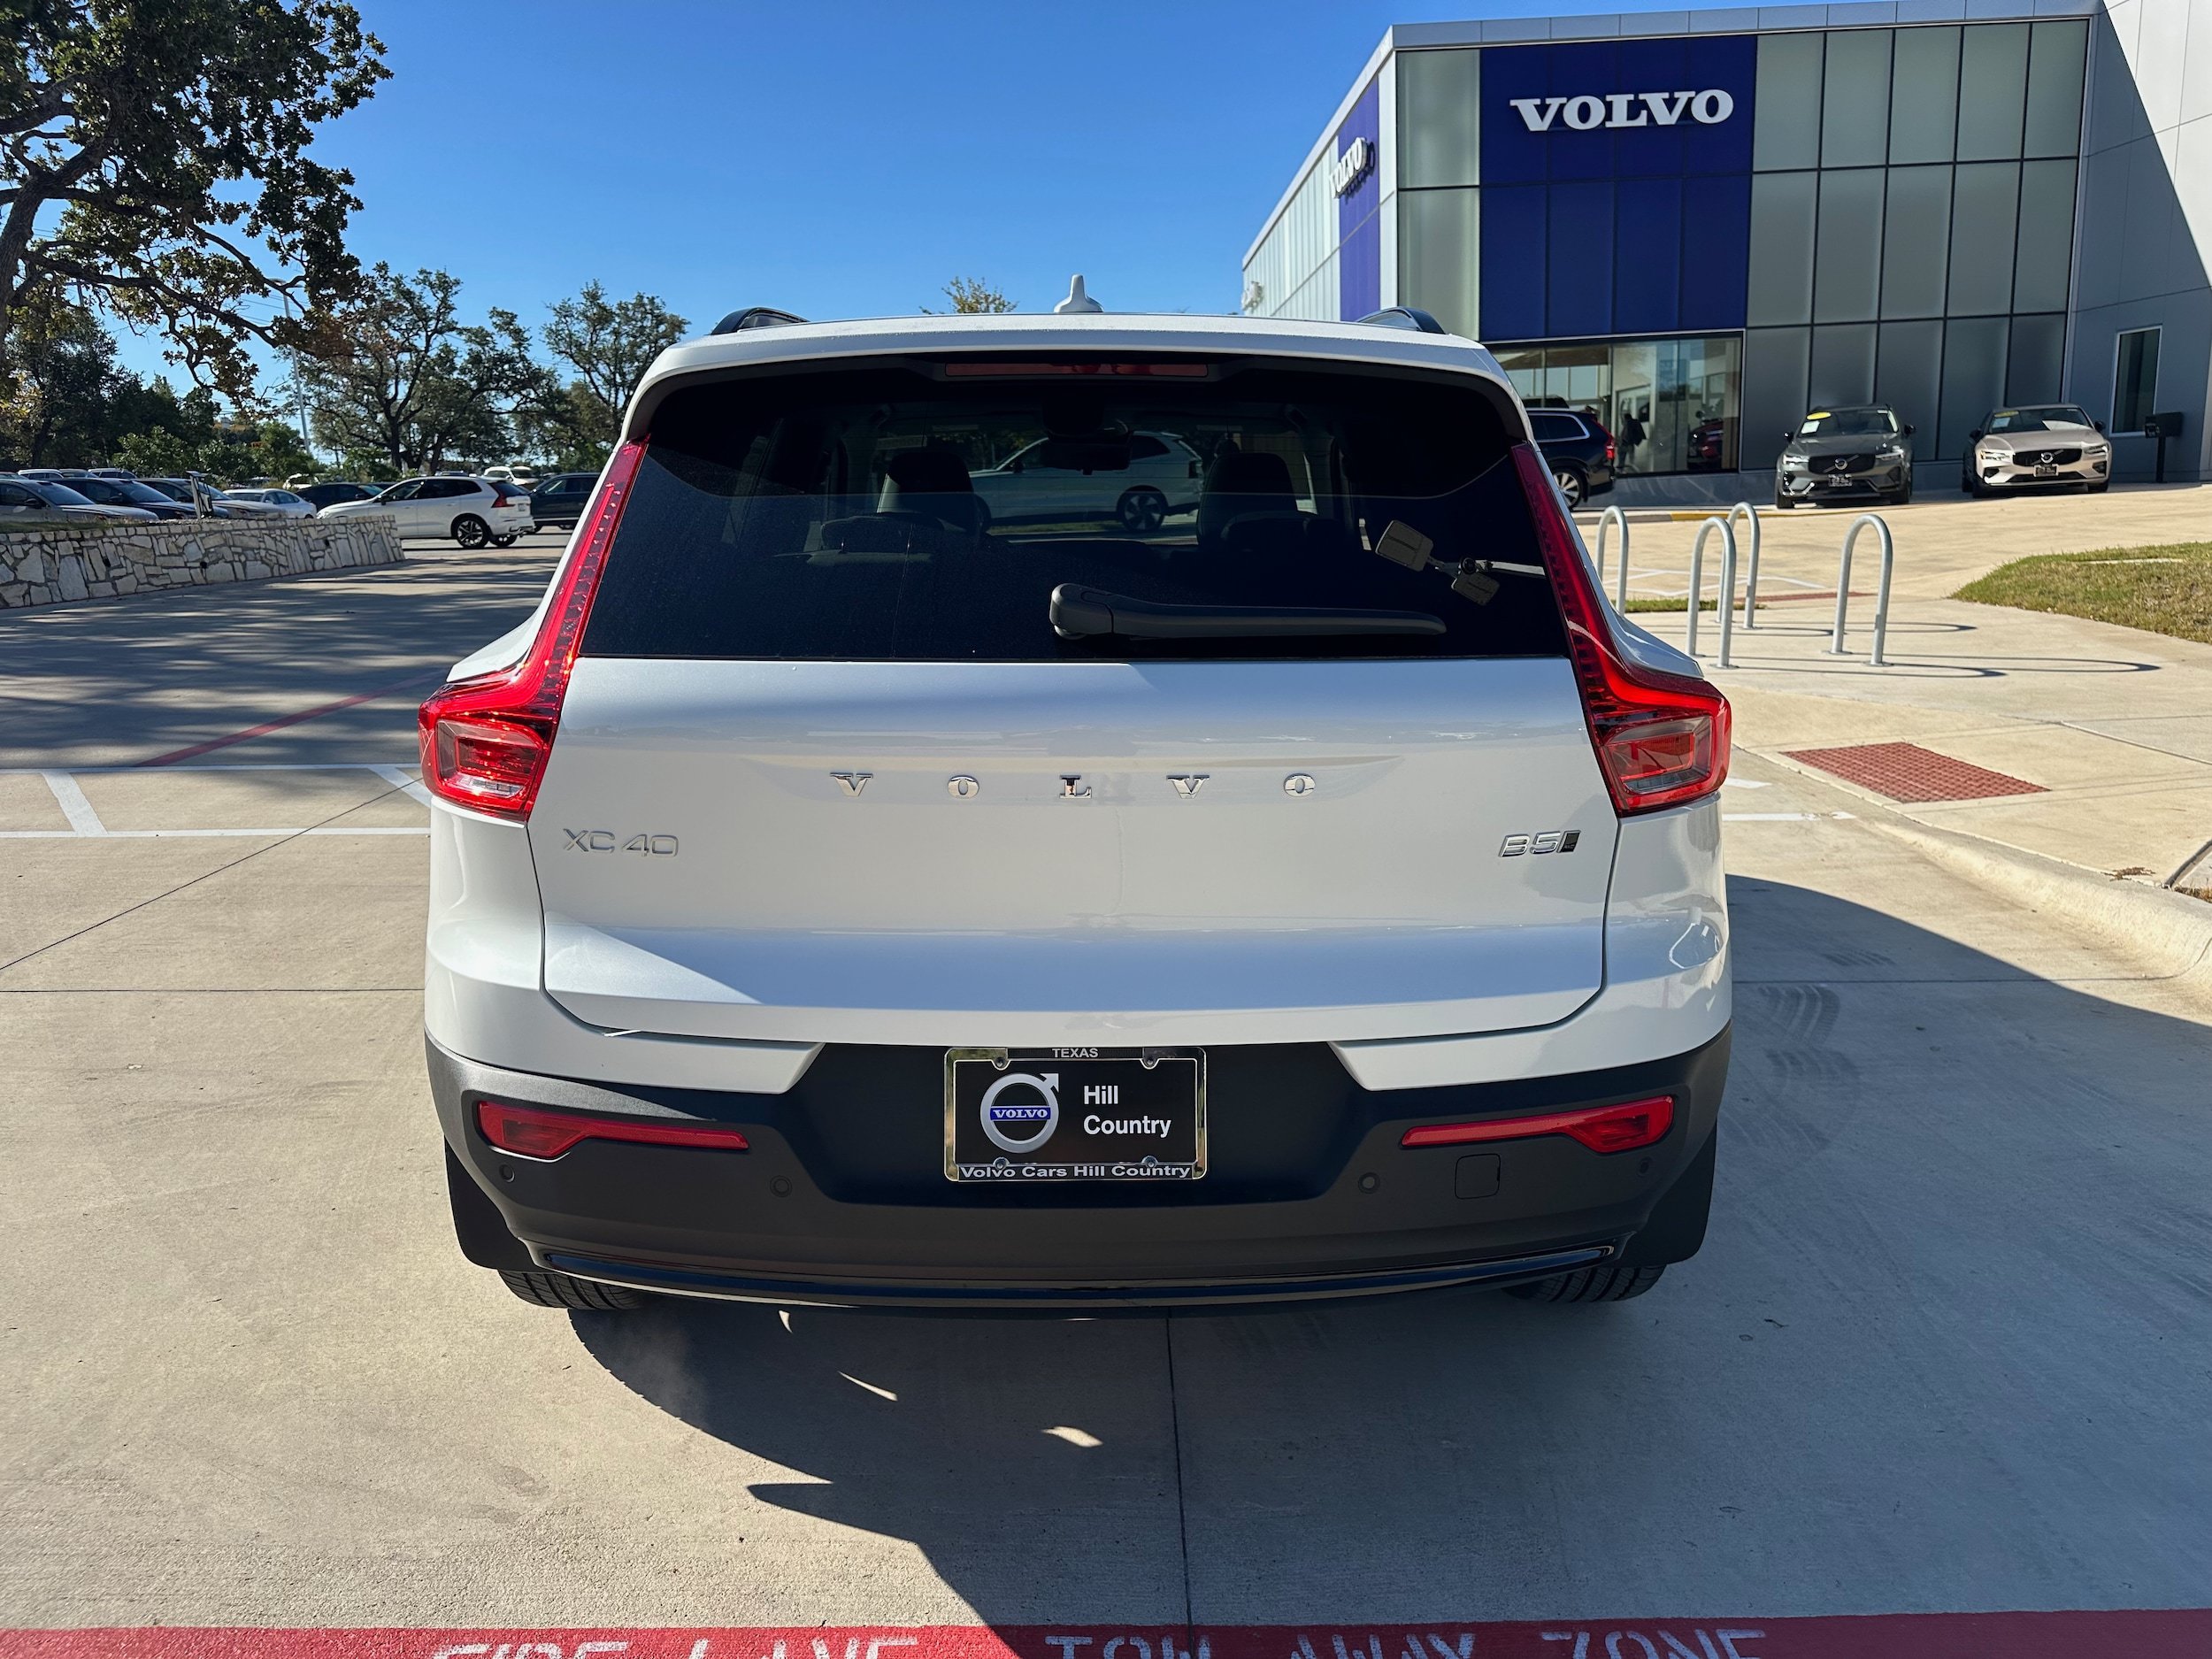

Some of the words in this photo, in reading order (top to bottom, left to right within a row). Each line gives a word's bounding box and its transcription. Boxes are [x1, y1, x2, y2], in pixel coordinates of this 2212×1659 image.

[1509, 88, 1734, 132] VOLVO
[1329, 136, 1367, 199] VOLVO
[830, 772, 1317, 799] VOLVO
[1052, 1048, 1099, 1058] TEXAS
[1083, 1085, 1119, 1105] Hill
[992, 1109, 1048, 1119] VOLVO
[1083, 1115, 1171, 1139] Country
[960, 1166, 1016, 1178] Volvo
[1022, 1165, 1067, 1177] Cars
[1073, 1165, 1105, 1177] Hill
[1110, 1164, 1191, 1178] Country
